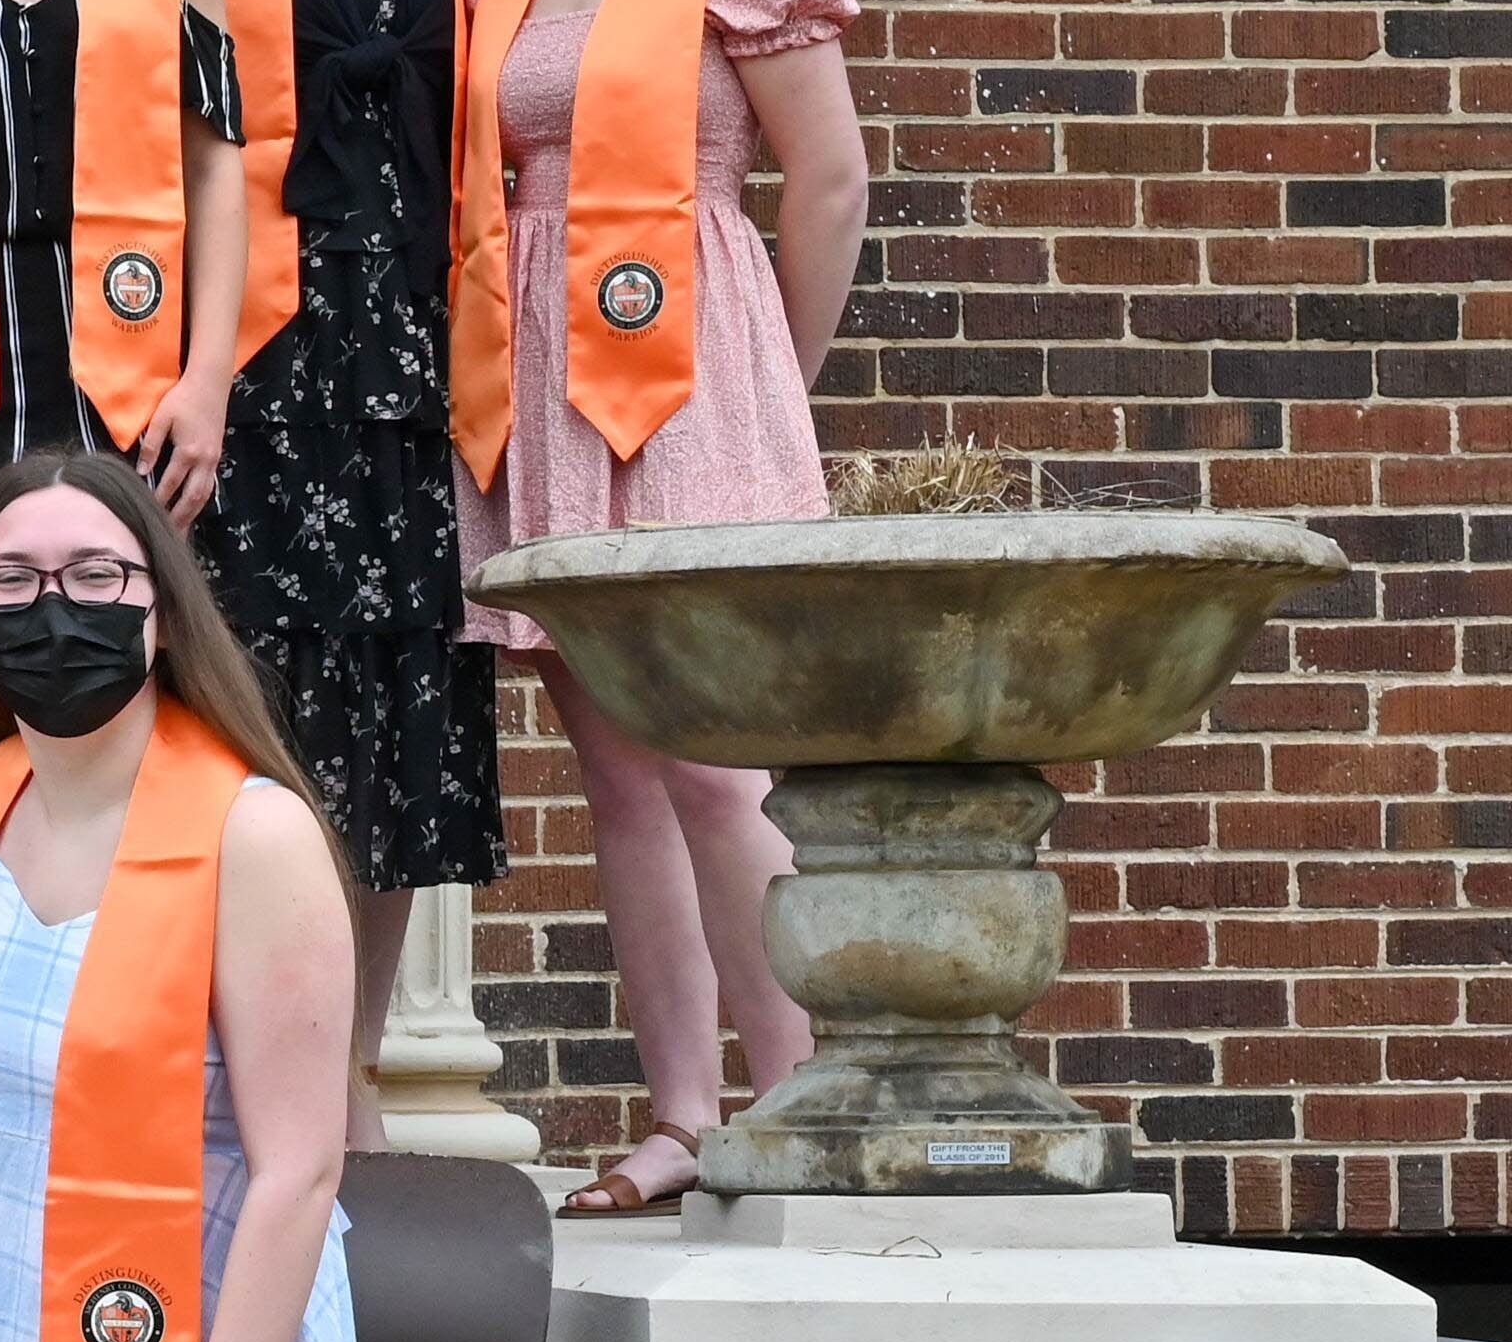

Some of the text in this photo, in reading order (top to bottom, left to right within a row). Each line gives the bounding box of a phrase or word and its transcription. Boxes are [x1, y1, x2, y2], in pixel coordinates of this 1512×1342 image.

[95, 242, 168, 274] DISTINGUISHED
[590, 251, 670, 287] DISTINGUISHED
[111, 316, 160, 334] WARRIOR
[607, 322, 661, 342] WARRIOR
[72, 1267, 173, 1307] DISTINGUISHED
